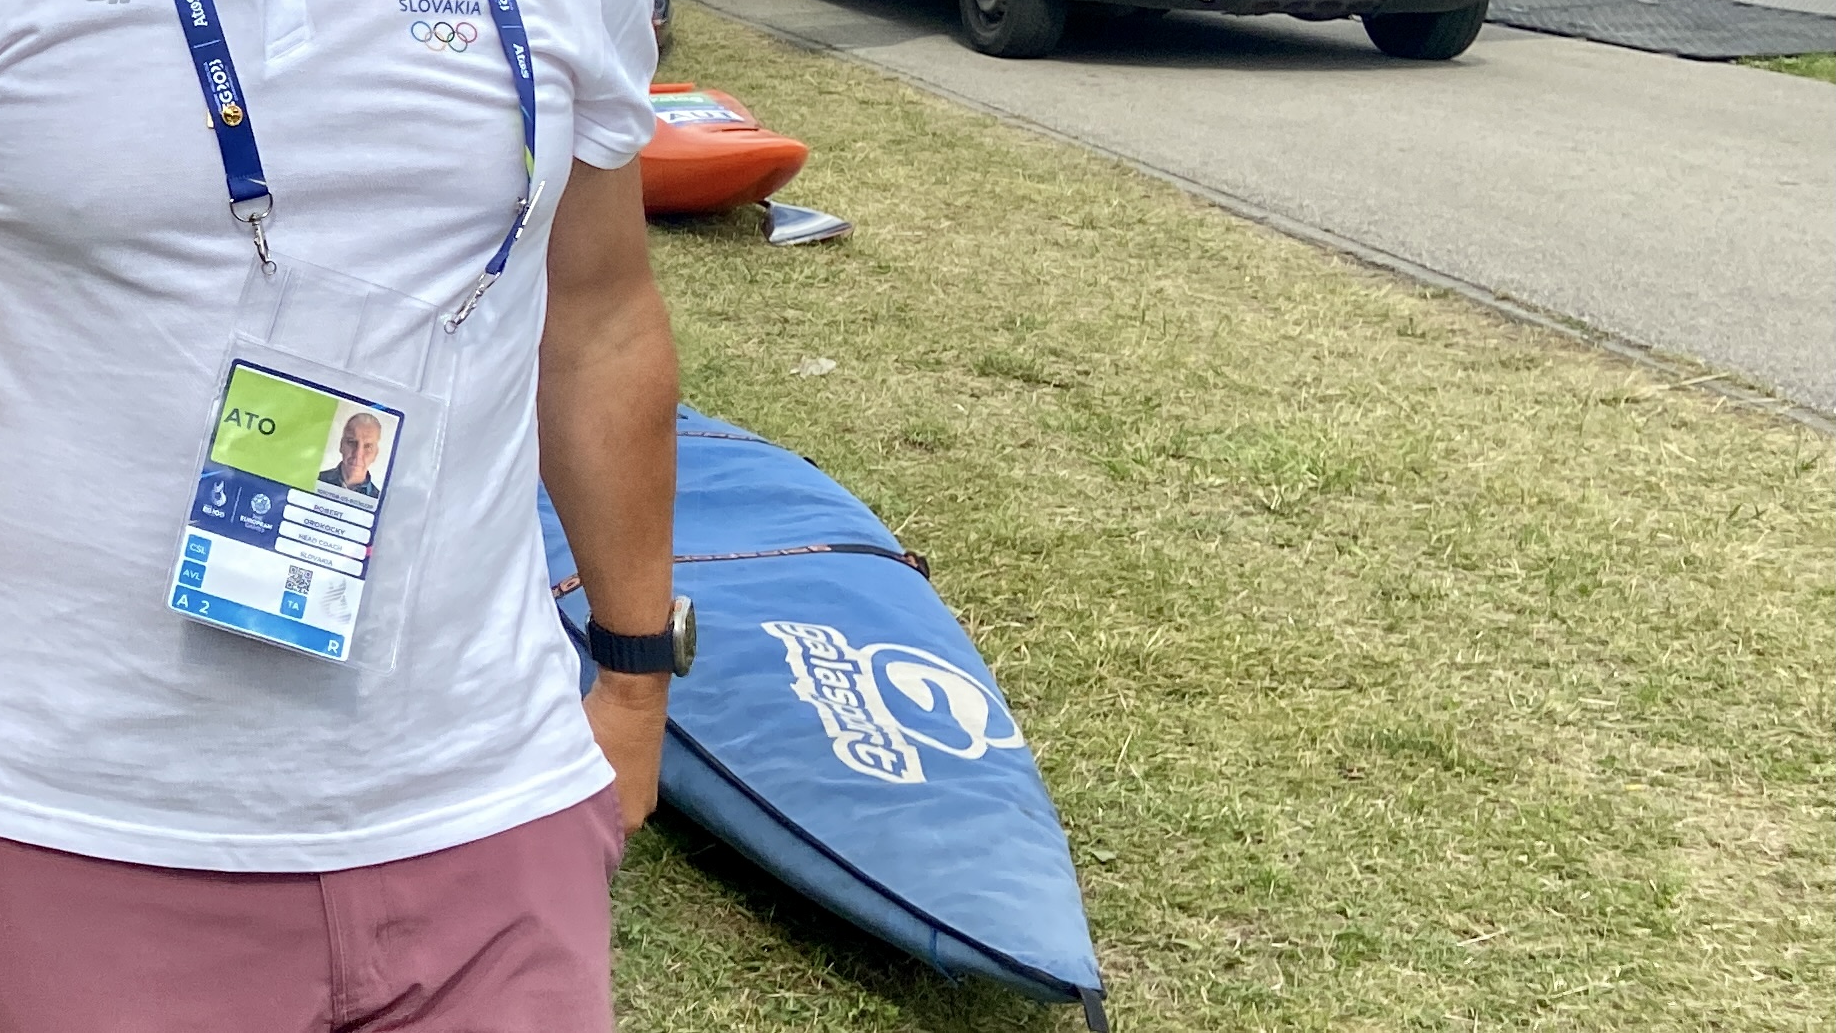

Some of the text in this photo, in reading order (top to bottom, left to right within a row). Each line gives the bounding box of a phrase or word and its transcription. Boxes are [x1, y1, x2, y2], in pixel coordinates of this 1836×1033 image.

[512, 43, 530, 79] Atos
[223, 408, 276, 436] ATO
[176, 593, 340, 655] A 2 R
